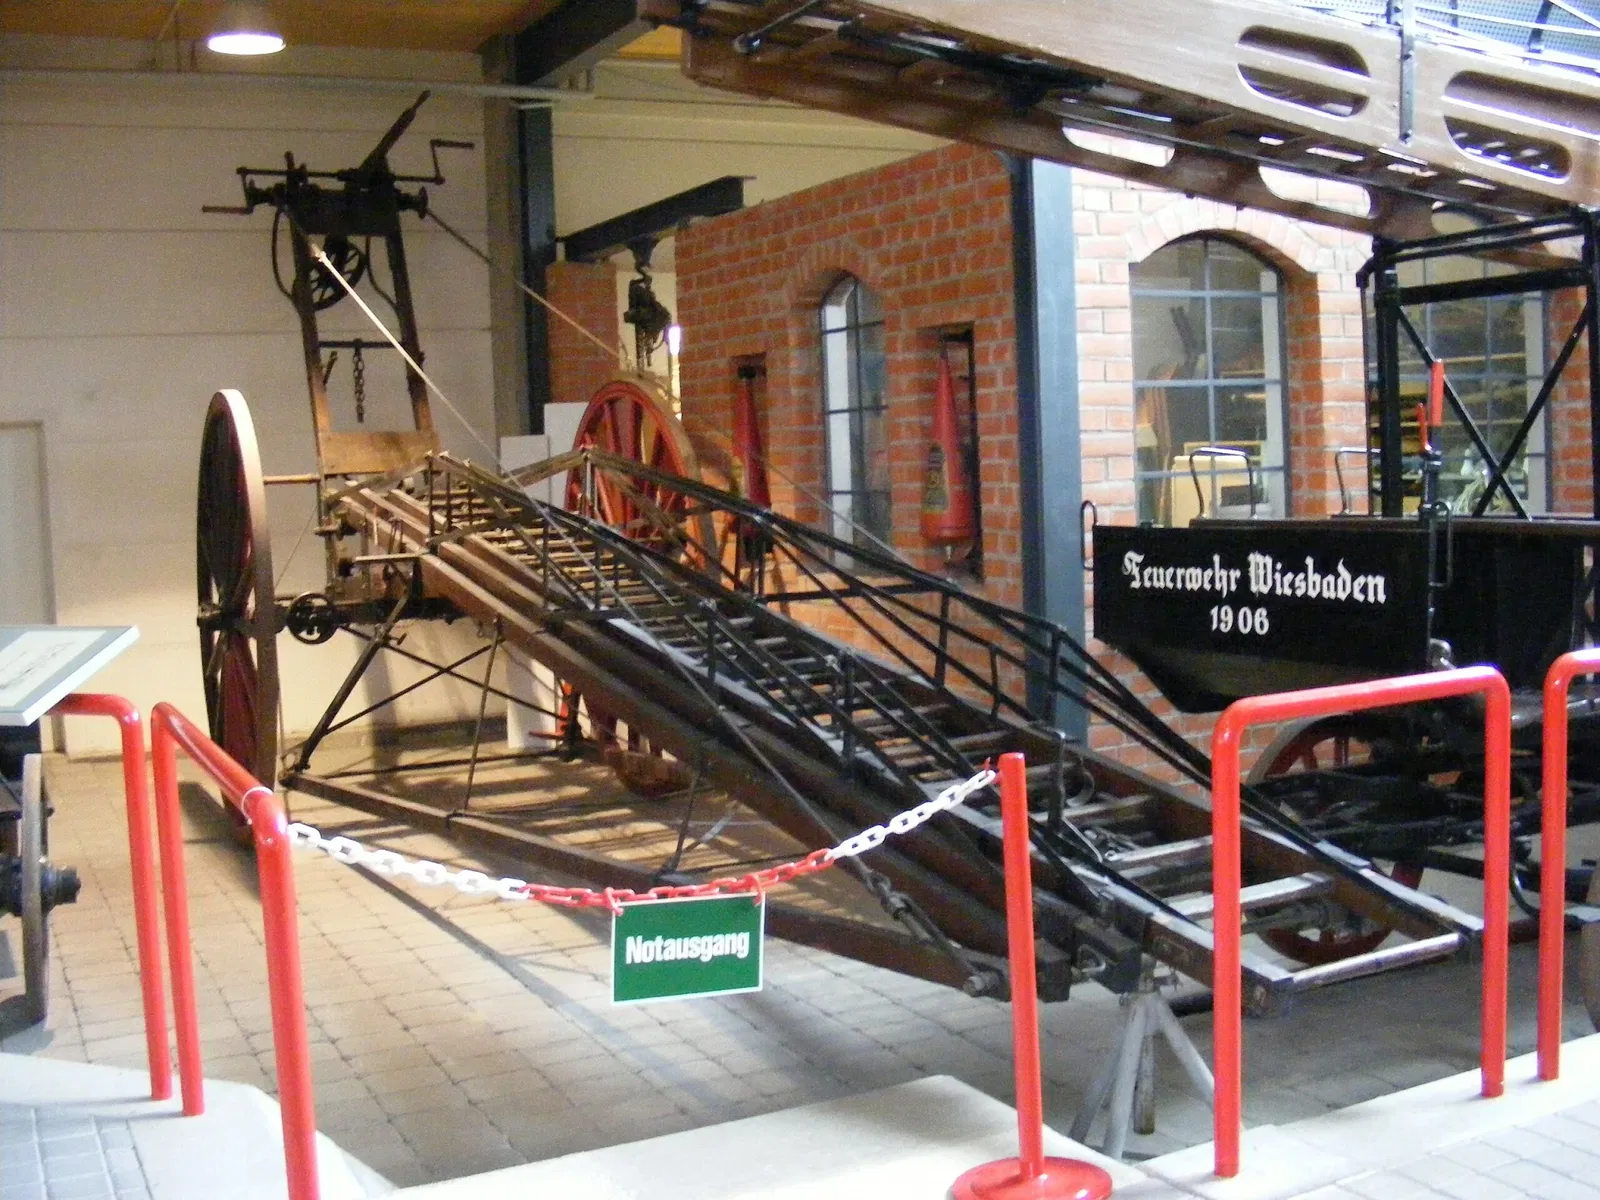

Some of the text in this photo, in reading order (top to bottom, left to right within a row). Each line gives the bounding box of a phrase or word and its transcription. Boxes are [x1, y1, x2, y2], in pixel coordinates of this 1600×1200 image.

[1121, 550, 1387, 604] Feuerwehr Wiesbaden
[1210, 605, 1270, 636] 1906
[625, 931, 750, 965] Notausgang
